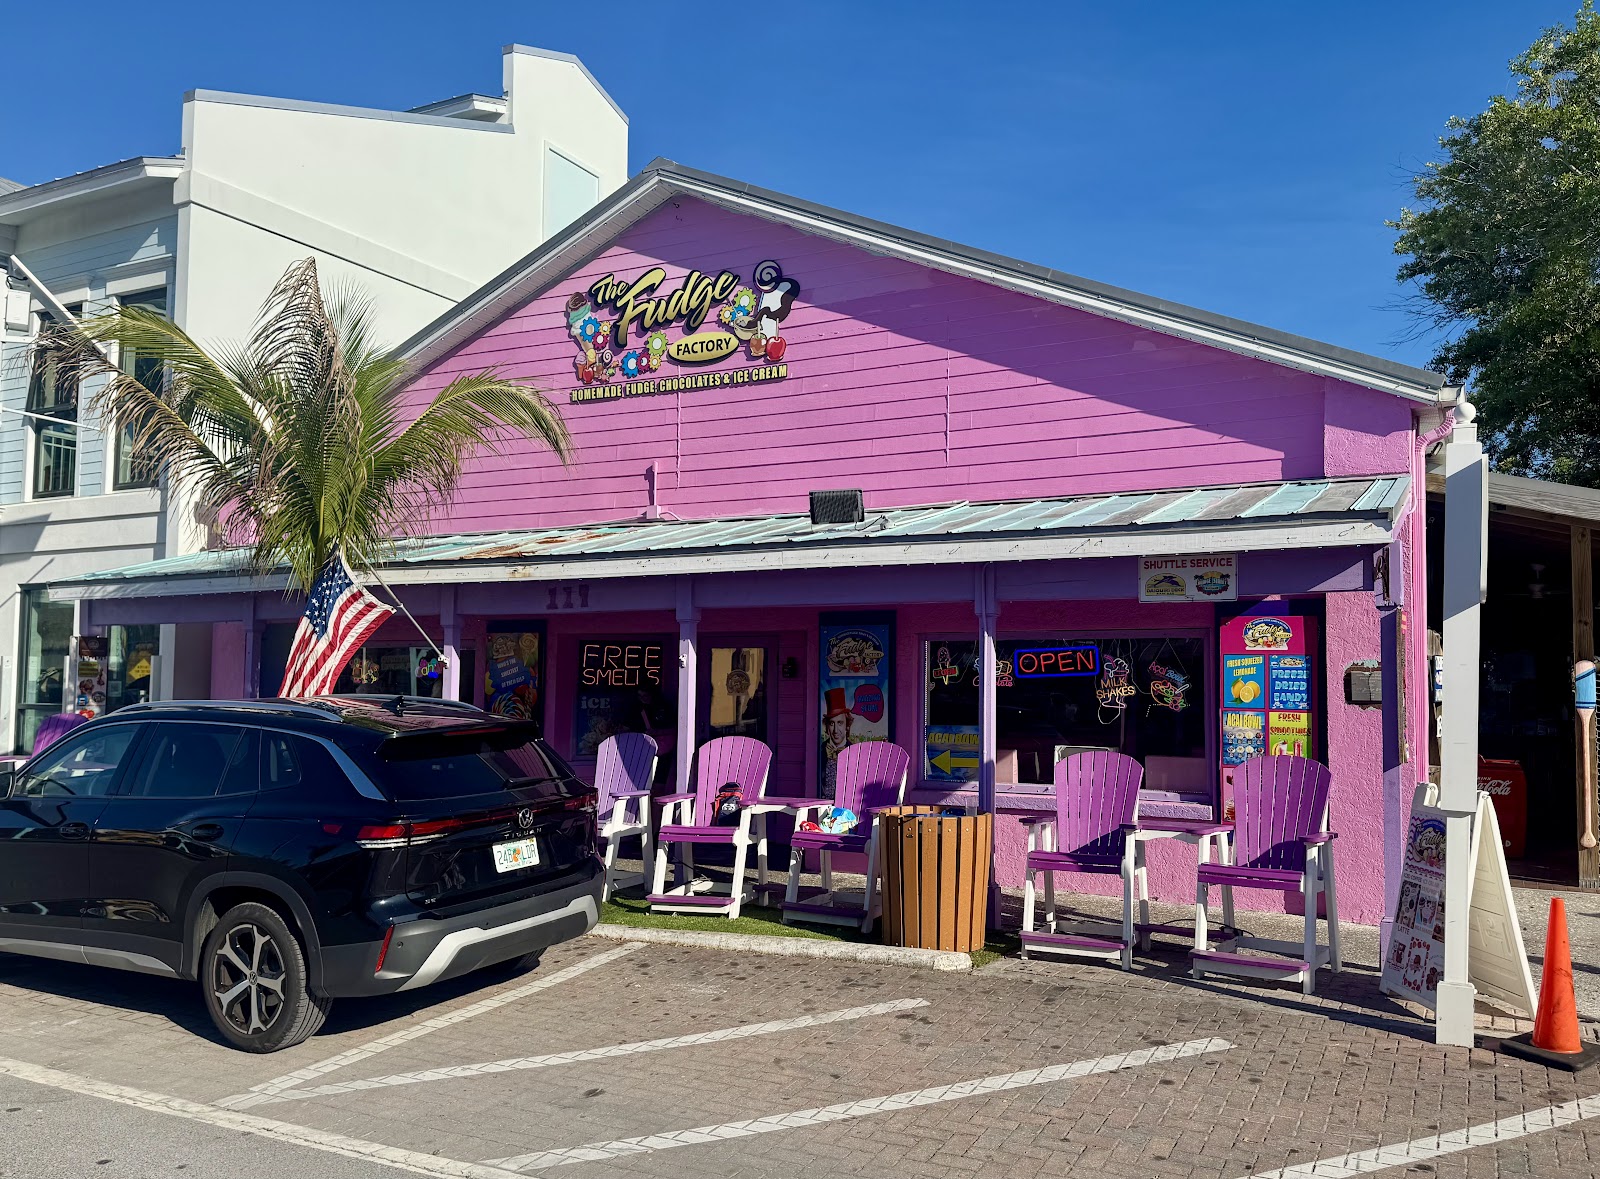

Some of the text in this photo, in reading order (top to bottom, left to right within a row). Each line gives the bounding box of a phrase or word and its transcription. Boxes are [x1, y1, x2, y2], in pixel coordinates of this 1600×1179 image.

[590, 273, 630, 305] The
[614, 267, 740, 348] Fudge
[676, 337, 732, 356] FACTORY
[571, 364, 788, 402] HOMEMADE FUDGE, CHOCOLATES & ICE CREAM
[1143, 557, 1233, 570] SHUTTLE SERVICE
[546, 584, 590, 609] 117
[583, 644, 662, 669] FREE
[1019, 651, 1094, 673] OPEN
[1227, 659, 1242, 668] FRESH
[1233, 667, 1256, 677] LEMONADE
[1272, 669, 1310, 680] FREEZE
[1101, 677, 1127, 688] MILK
[1275, 680, 1308, 691] DRIED
[1096, 685, 1135, 700] SHAKES
[1274, 692, 1308, 702] CANDY
[1227, 713, 1263, 730] ACAI BOWL
[1278, 713, 1301, 722] FRESH
[1270, 727, 1311, 736] SMOOTHIES
[928, 732, 980, 745] ACAI BOW
[503, 827, 542, 839] TIGUAN
[1397, 925, 1411, 935] LATTE
